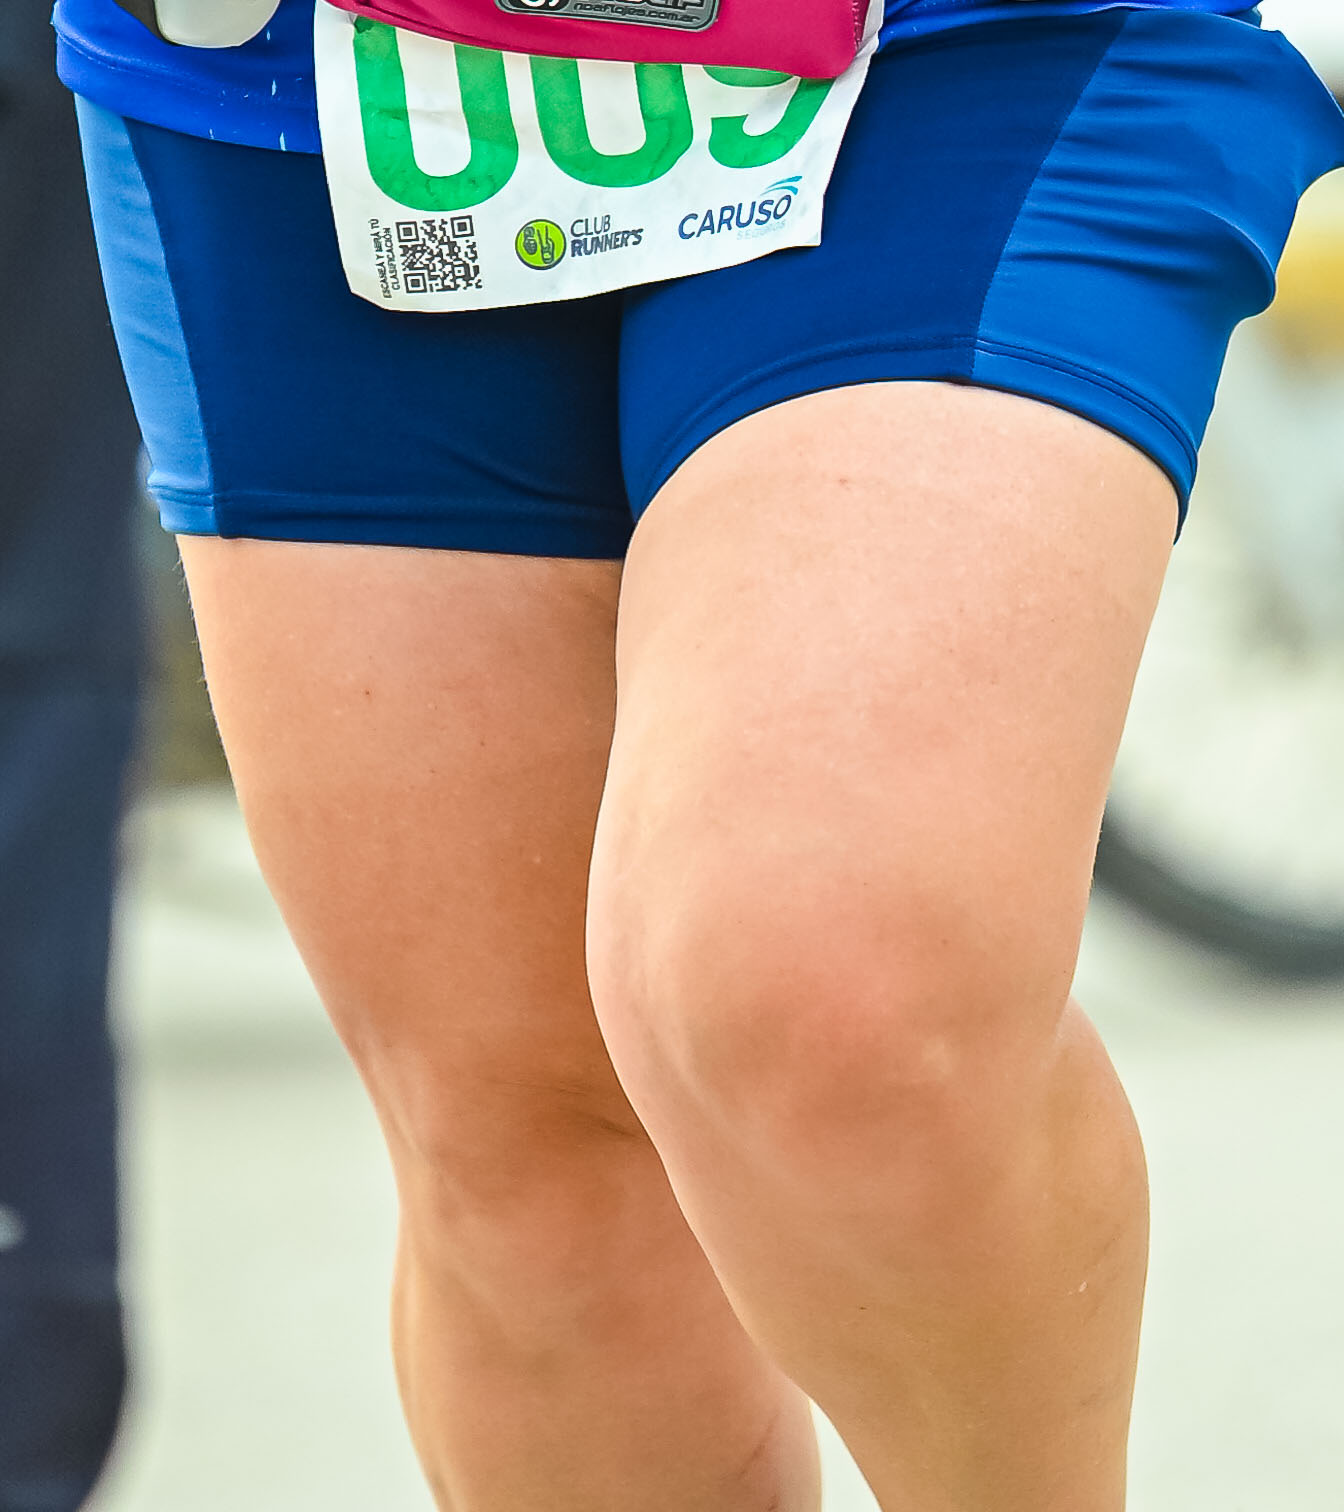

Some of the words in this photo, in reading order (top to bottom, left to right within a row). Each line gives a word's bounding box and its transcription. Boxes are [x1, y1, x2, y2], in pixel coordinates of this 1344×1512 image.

[570, 215, 611, 237] CLUB
[678, 194, 792, 240] CARUSO
[570, 228, 644, 258] RUNNER'S
